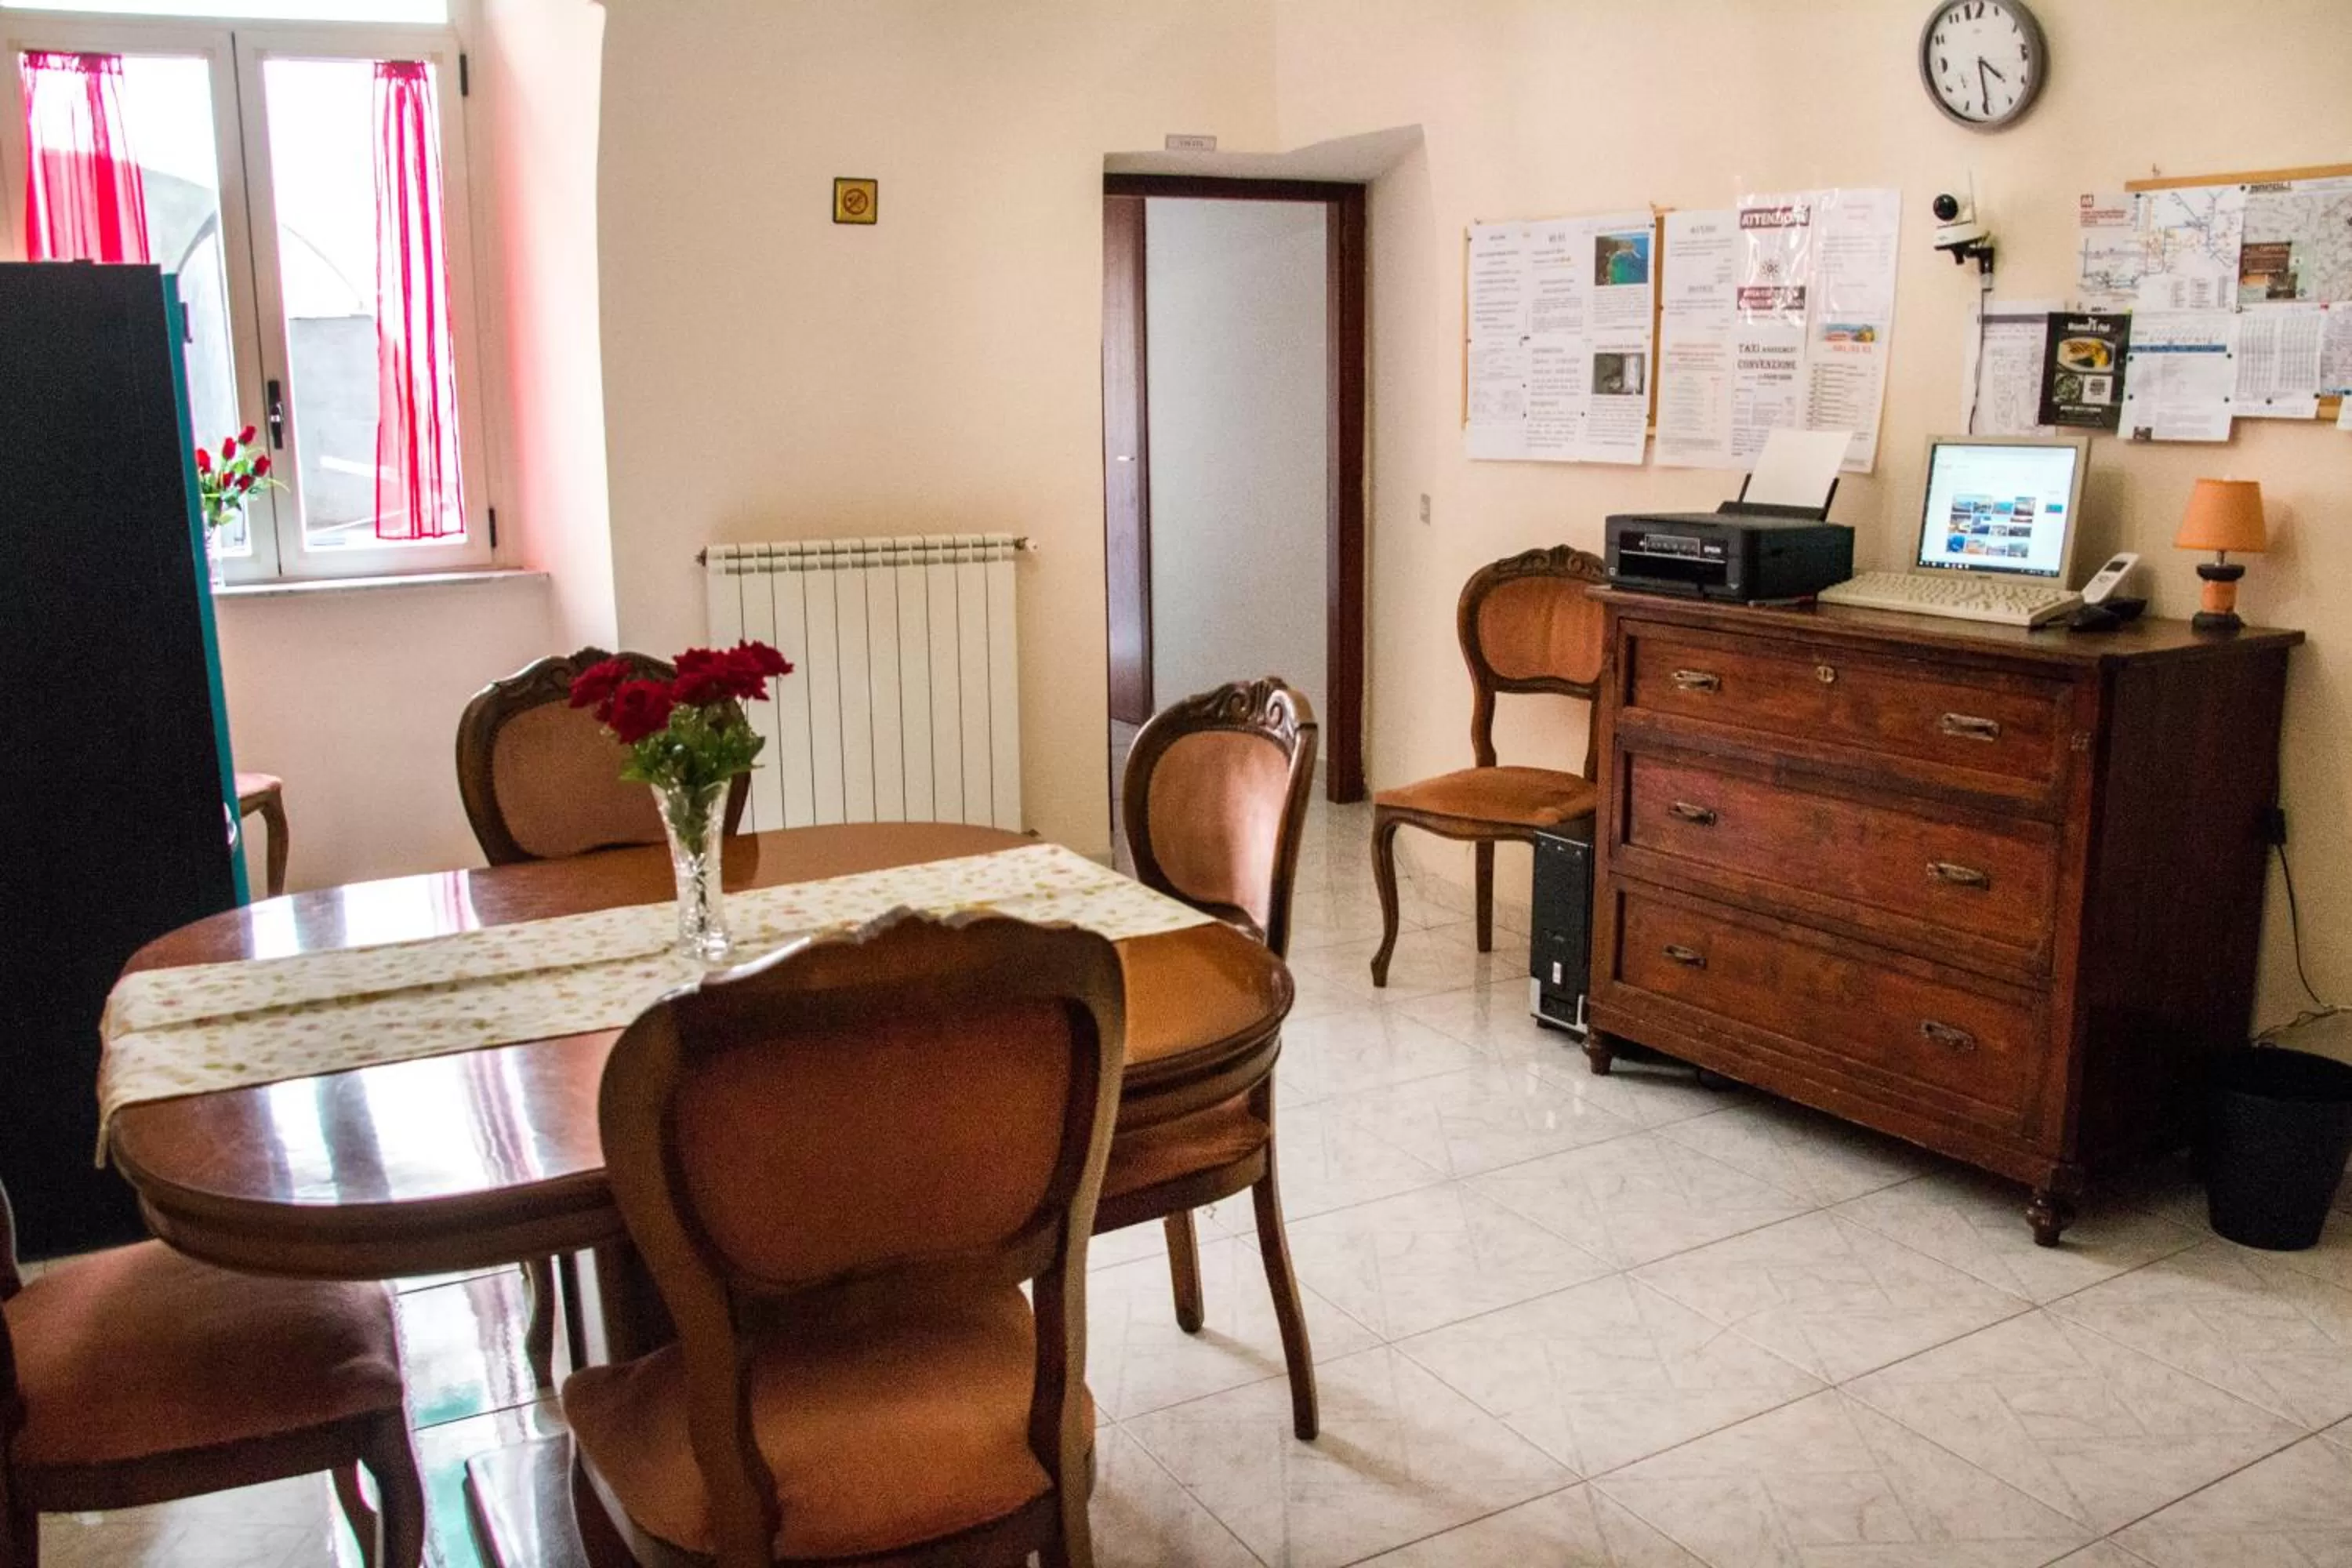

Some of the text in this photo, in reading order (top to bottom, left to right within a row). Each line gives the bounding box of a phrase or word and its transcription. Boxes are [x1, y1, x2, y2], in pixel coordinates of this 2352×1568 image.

[1964, 1, 1985, 20] 12
[1741, 212, 1806, 227] ATTENZIO
[1738, 343, 1760, 353] TAXI
